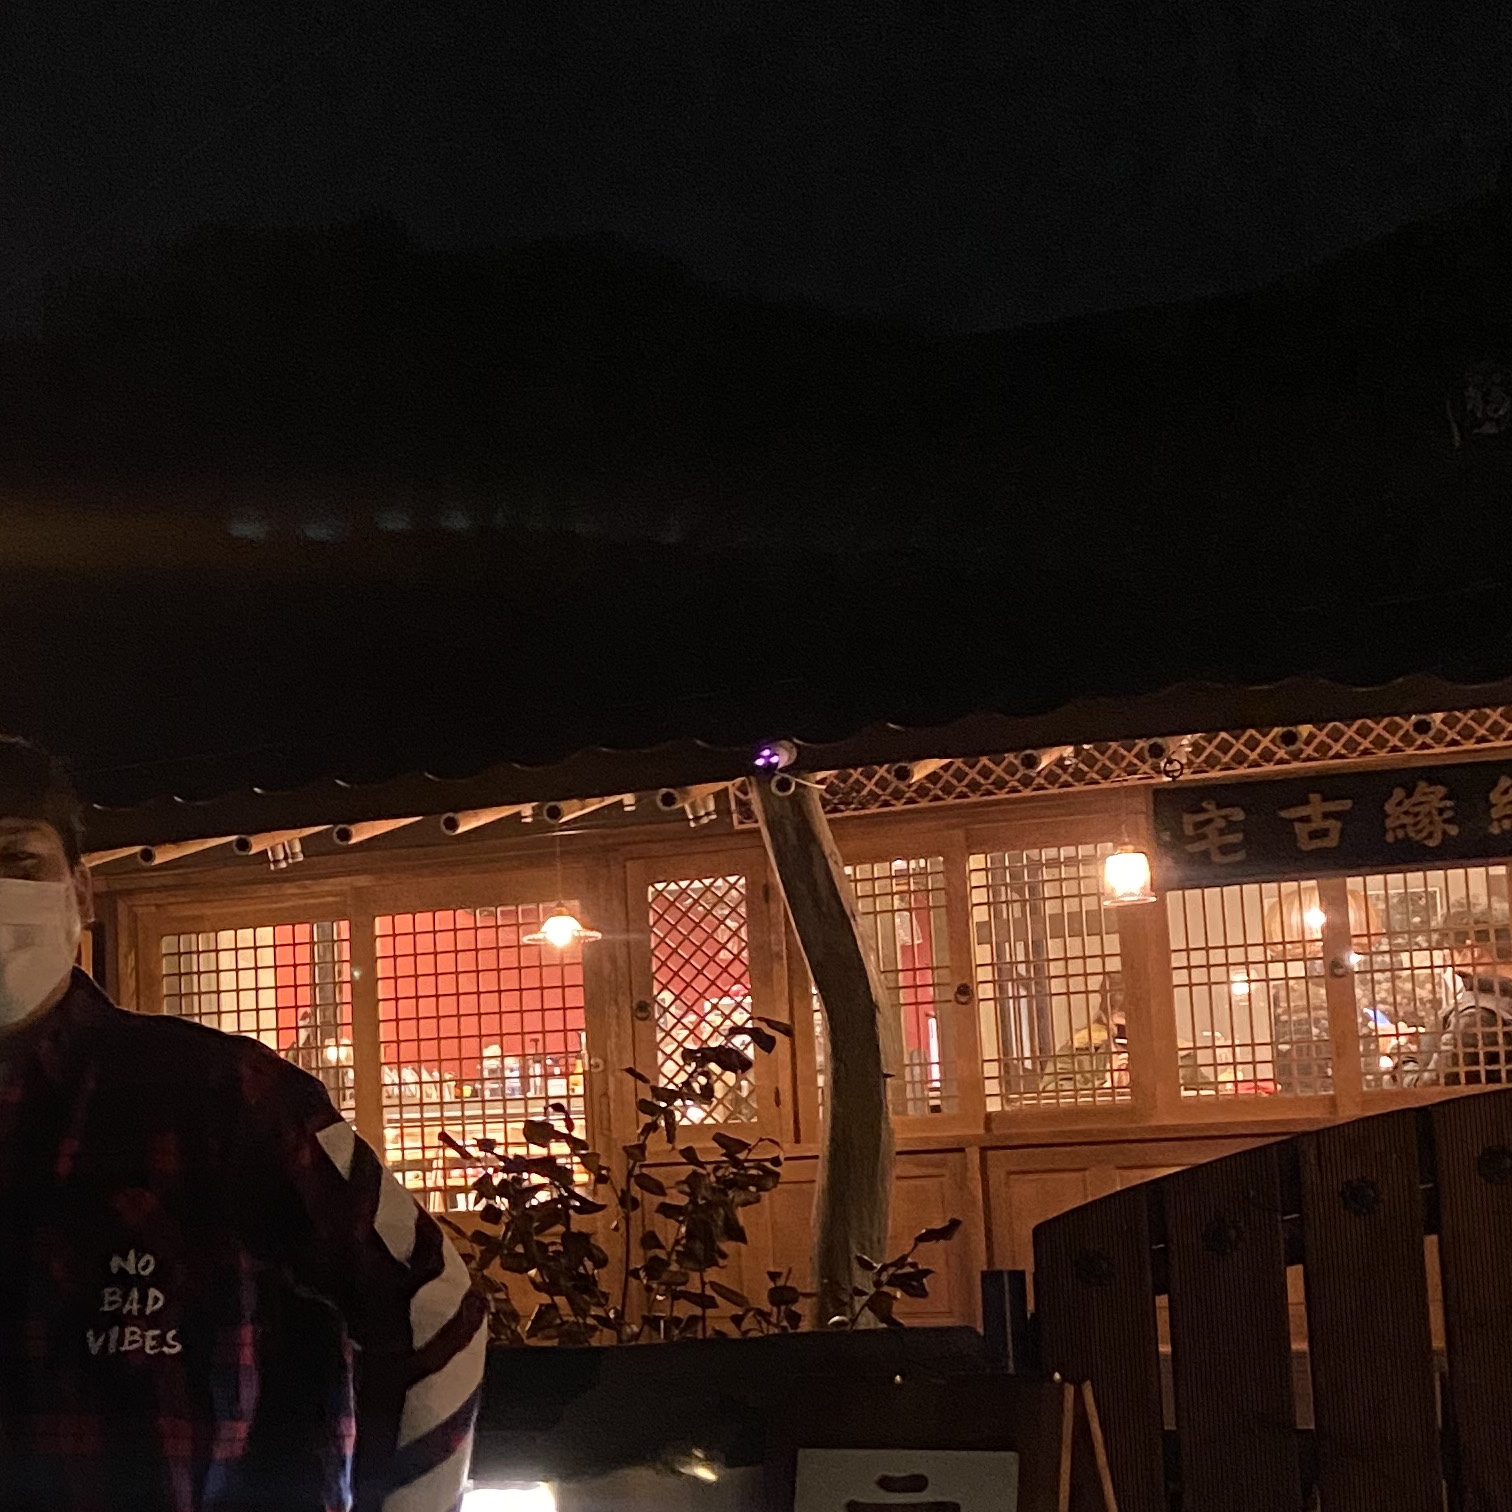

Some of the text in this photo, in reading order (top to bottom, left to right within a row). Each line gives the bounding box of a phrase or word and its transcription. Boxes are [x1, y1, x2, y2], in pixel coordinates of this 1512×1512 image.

[109, 1248, 156, 1276] NO
[99, 1287, 165, 1316] BAD
[86, 1325, 183, 1355] VIBES
